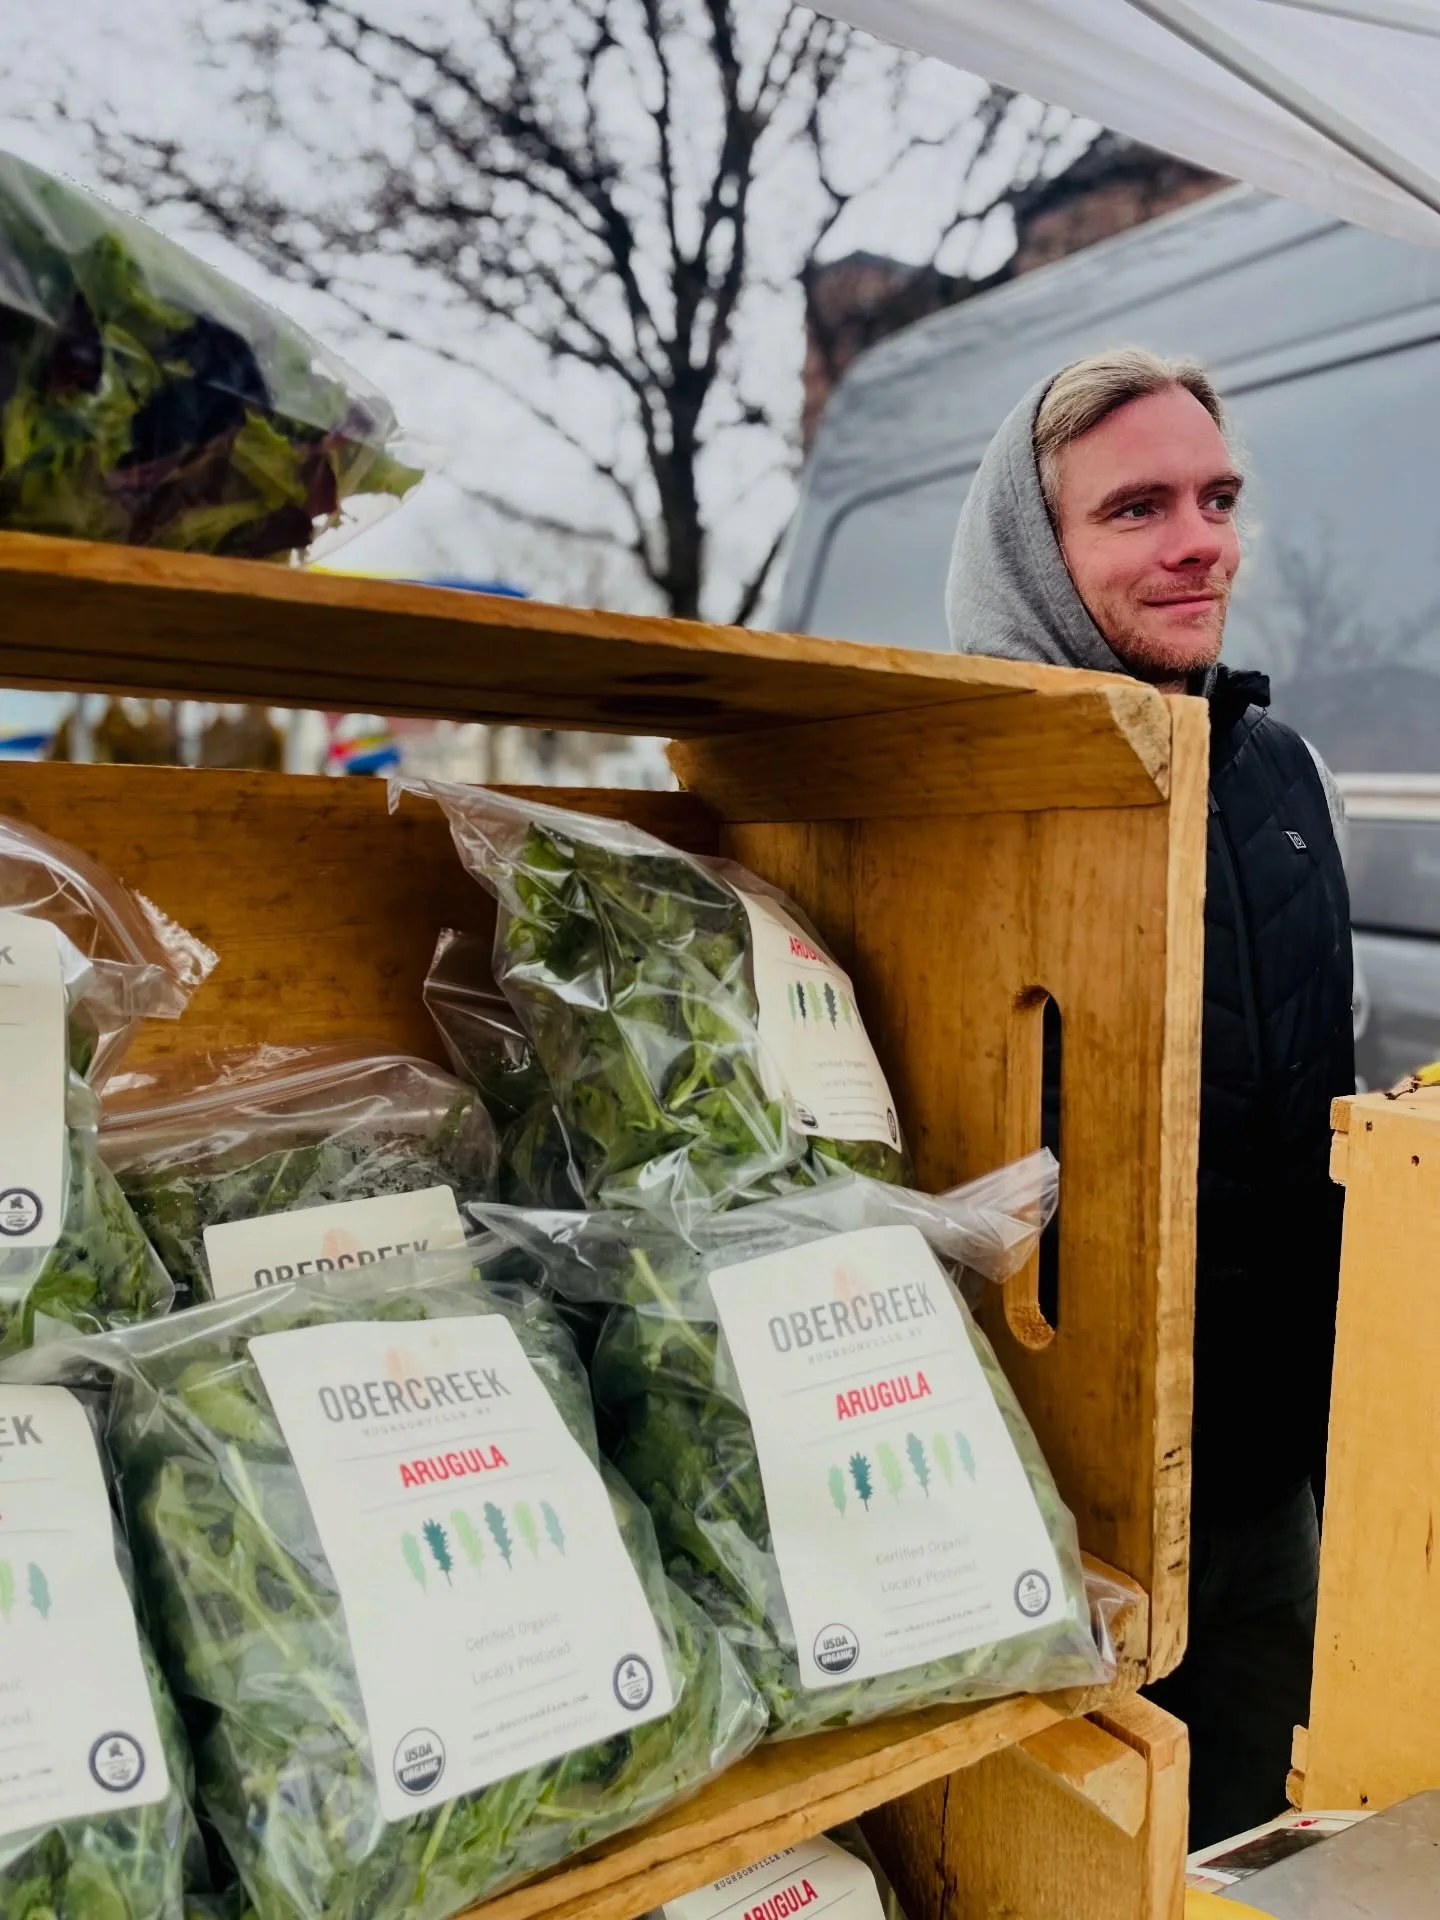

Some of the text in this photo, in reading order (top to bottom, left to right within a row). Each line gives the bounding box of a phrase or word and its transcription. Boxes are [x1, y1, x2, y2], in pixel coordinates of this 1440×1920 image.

[768, 1281, 937, 1353] OBERCREEK
[318, 1367, 512, 1423] OBERCREEK
[835, 1371, 932, 1421] ARUGULA
[399, 1444, 509, 1488] ARUGULA
[823, 1635, 848, 1650] USDA
[404, 1742, 432, 1762] USDA
